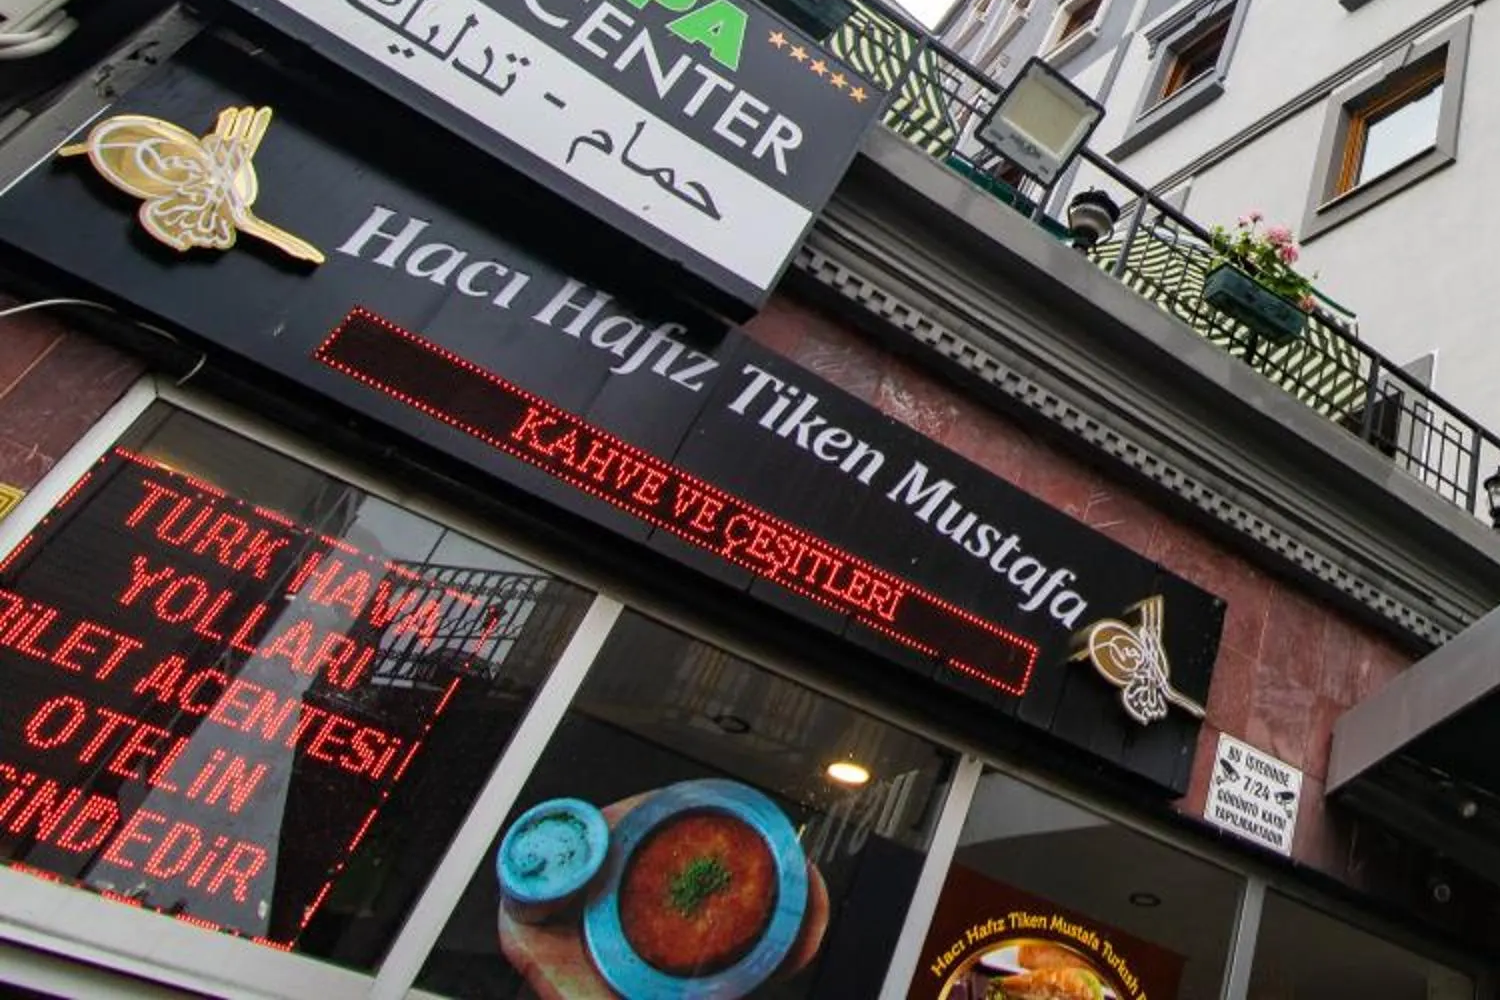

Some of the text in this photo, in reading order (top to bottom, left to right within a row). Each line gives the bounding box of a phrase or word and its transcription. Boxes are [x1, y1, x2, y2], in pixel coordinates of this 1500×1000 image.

[566, 120, 721, 221] حمام
[510, 406, 669, 506] KAHVE
[672, 483, 725, 534] VE
[728, 364, 886, 486] Tiken
[887, 460, 1088, 630] Mustafa
[119, 555, 375, 690] YOLLARI
[125, 478, 441, 648] TÜRK HAVA
[1243, 775, 1270, 801] 7/24
[1007, 911, 1048, 930] Tiken
[1049, 914, 1100, 950] Mustafa
